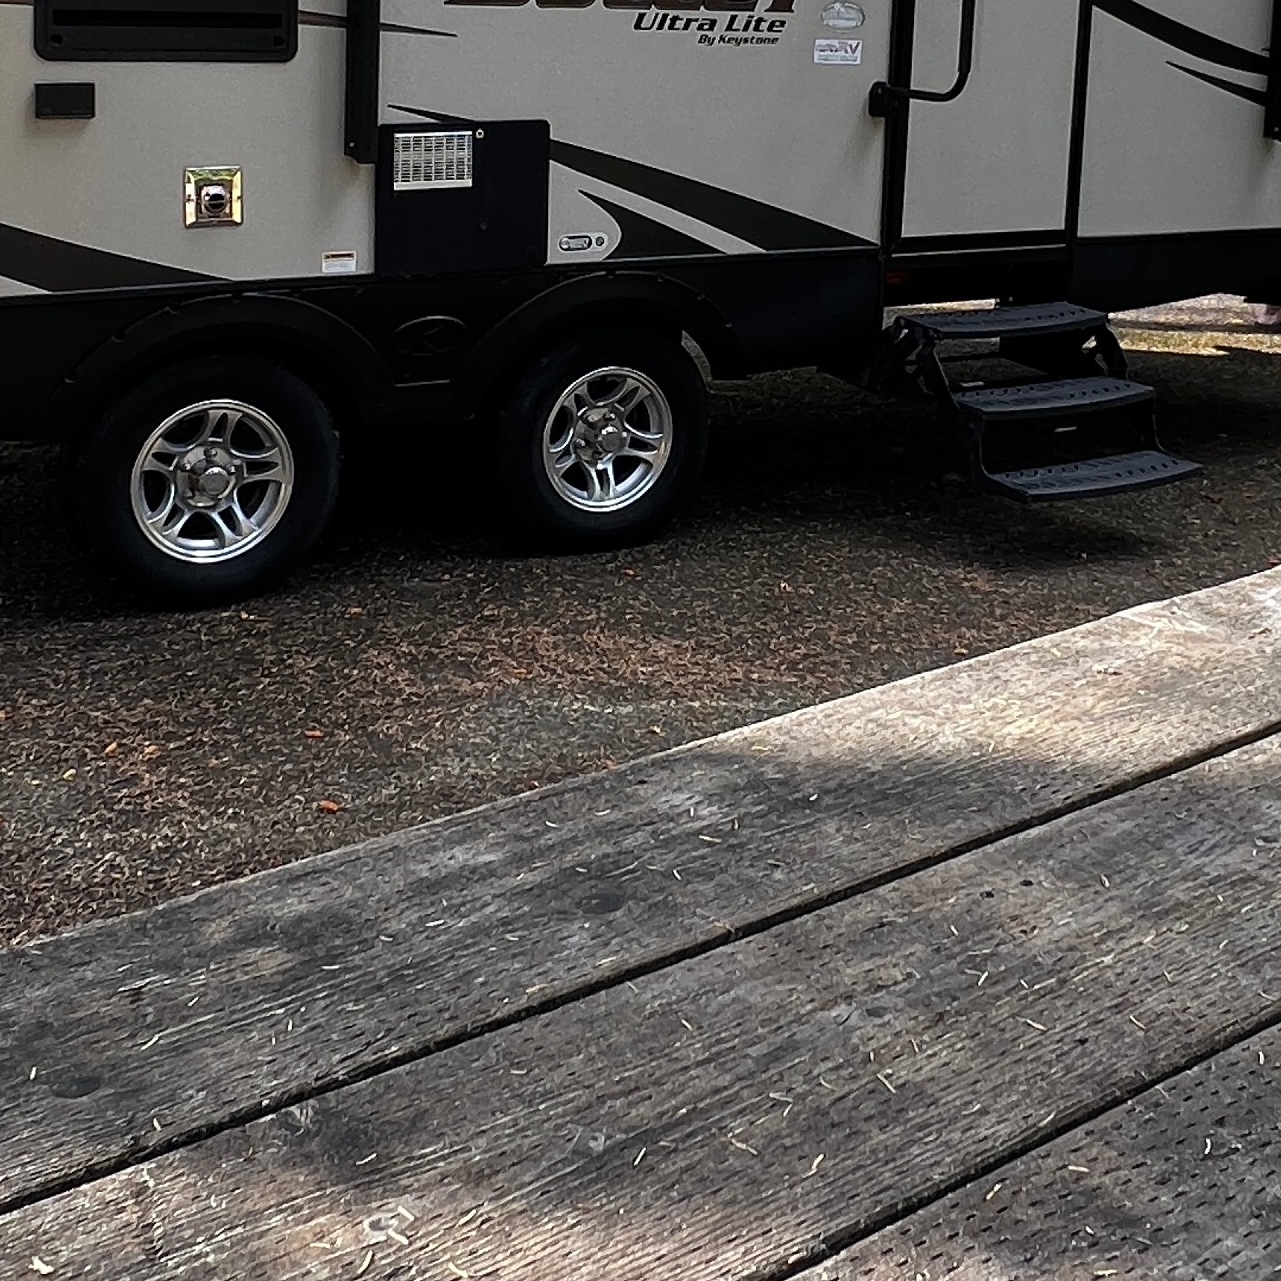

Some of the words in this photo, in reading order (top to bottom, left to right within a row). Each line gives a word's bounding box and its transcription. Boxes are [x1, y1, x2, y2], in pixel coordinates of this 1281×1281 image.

[632, 11, 718, 32] Ultra
[723, 13, 787, 33] Lite
[697, 34, 717, 47] By
[717, 35, 780, 48] Keystone
